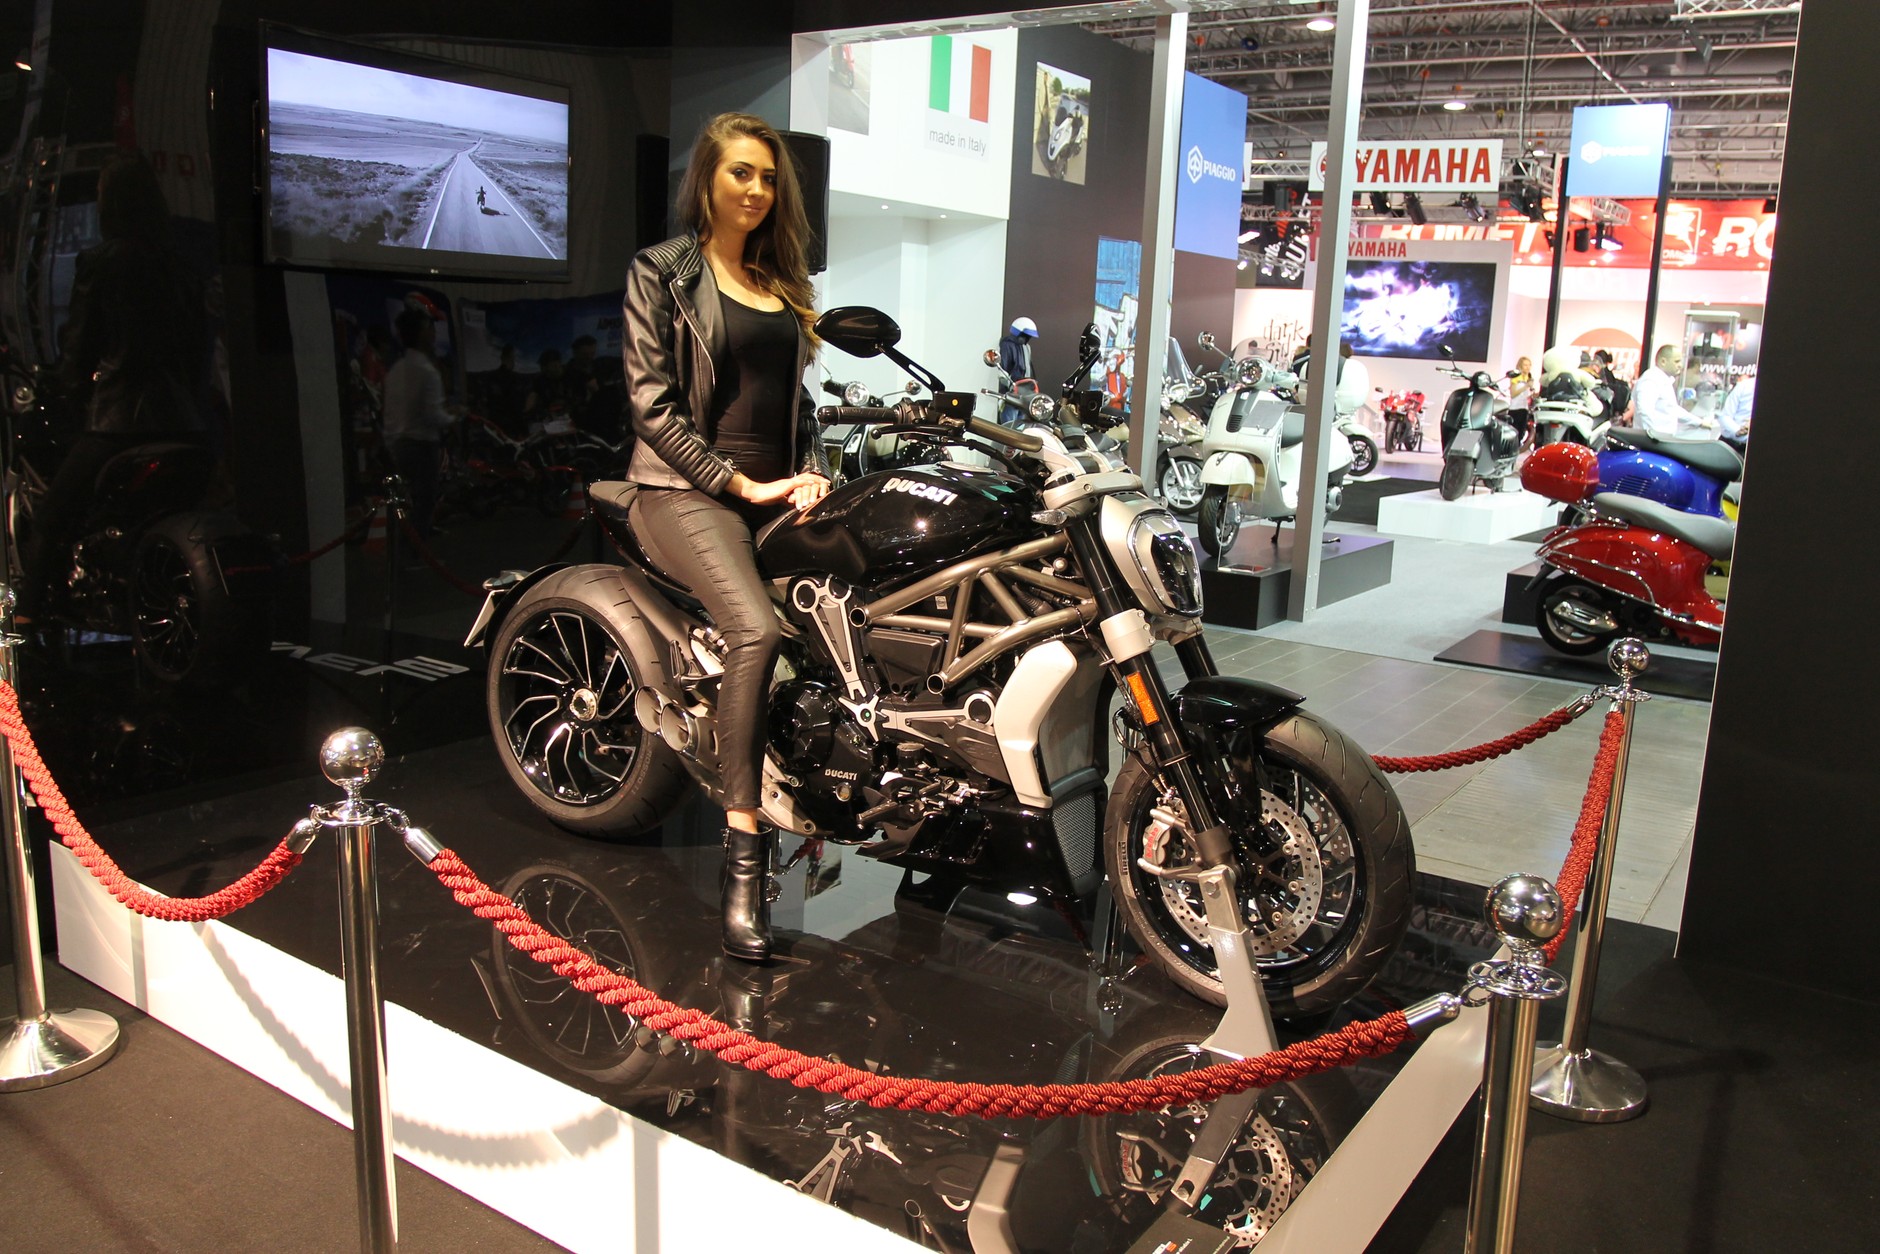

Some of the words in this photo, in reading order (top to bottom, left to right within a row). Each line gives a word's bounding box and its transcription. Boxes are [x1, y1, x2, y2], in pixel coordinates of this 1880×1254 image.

[929, 129, 956, 147] made
[957, 133, 966, 149] in
[968, 136, 987, 157] Italy
[1203, 160, 1236, 182] PIAGGIO
[1355, 147, 1492, 184] YAMAHA
[1348, 241, 1407, 258] YAMAHA
[1263, 319, 1305, 341] dark
[883, 477, 958, 506] DUCATI
[824, 768, 857, 781] DUCATI
